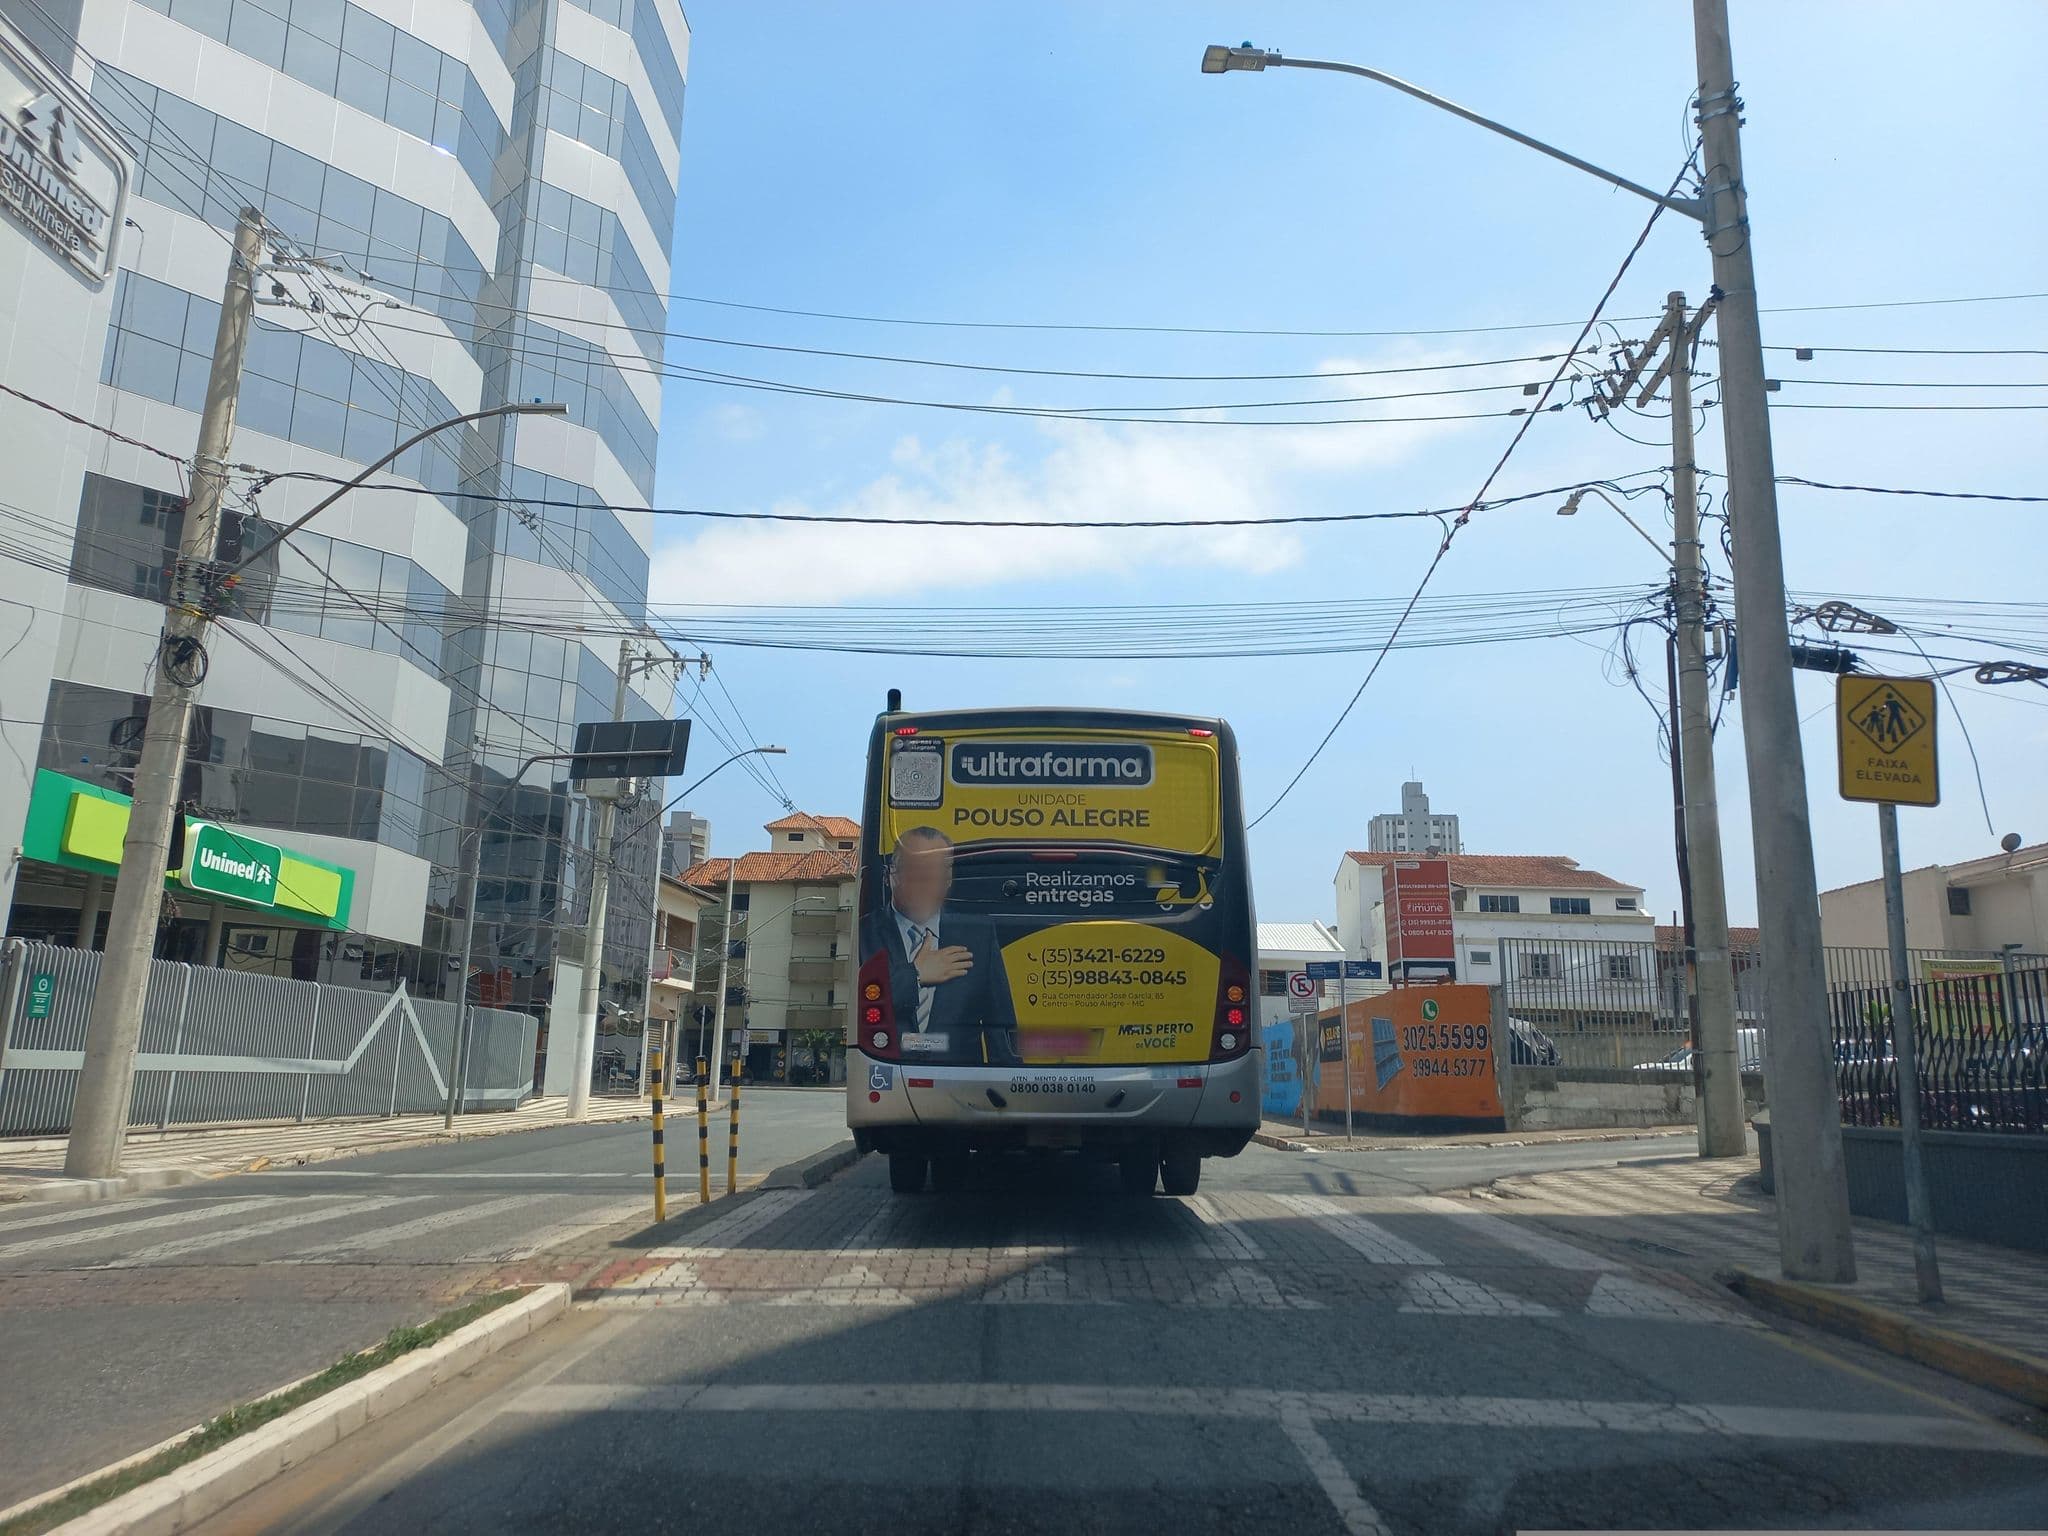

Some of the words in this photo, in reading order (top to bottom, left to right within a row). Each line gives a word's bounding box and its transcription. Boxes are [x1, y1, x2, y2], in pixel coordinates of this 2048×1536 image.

[2, 170, 26, 201] Sul
[29, 192, 81, 249] Mineira
[965, 751, 1142, 778] ultrafarma
[1868, 758, 1908, 769] FAIXA
[1856, 770, 1921, 784] ELEVADA
[1018, 794, 1086, 806] UNIDADE
[954, 808, 1044, 827] POUSO
[1051, 808, 1150, 827] ALEGRE
[200, 847, 256, 881] Unimed
[1026, 871, 1135, 886] Realizamos
[1025, 888, 1114, 907] entregas
[1042, 948, 1165, 967] (35)3421-6229
[1042, 970, 1187, 989] (35)98843-0845
[1100, 1000, 1125, 1009] Alegre
[1118, 1024, 1152, 1035] MAIS
[1156, 1023, 1194, 1034] PERTO
[1403, 1024, 1488, 1051] 3025.5599
[1143, 1035, 1176, 1049] VOCÊ
[1010, 1083, 1039, 1093] 0800
[1042, 1083, 1063, 1093] 038
[1067, 1083, 1096, 1093] 0140
